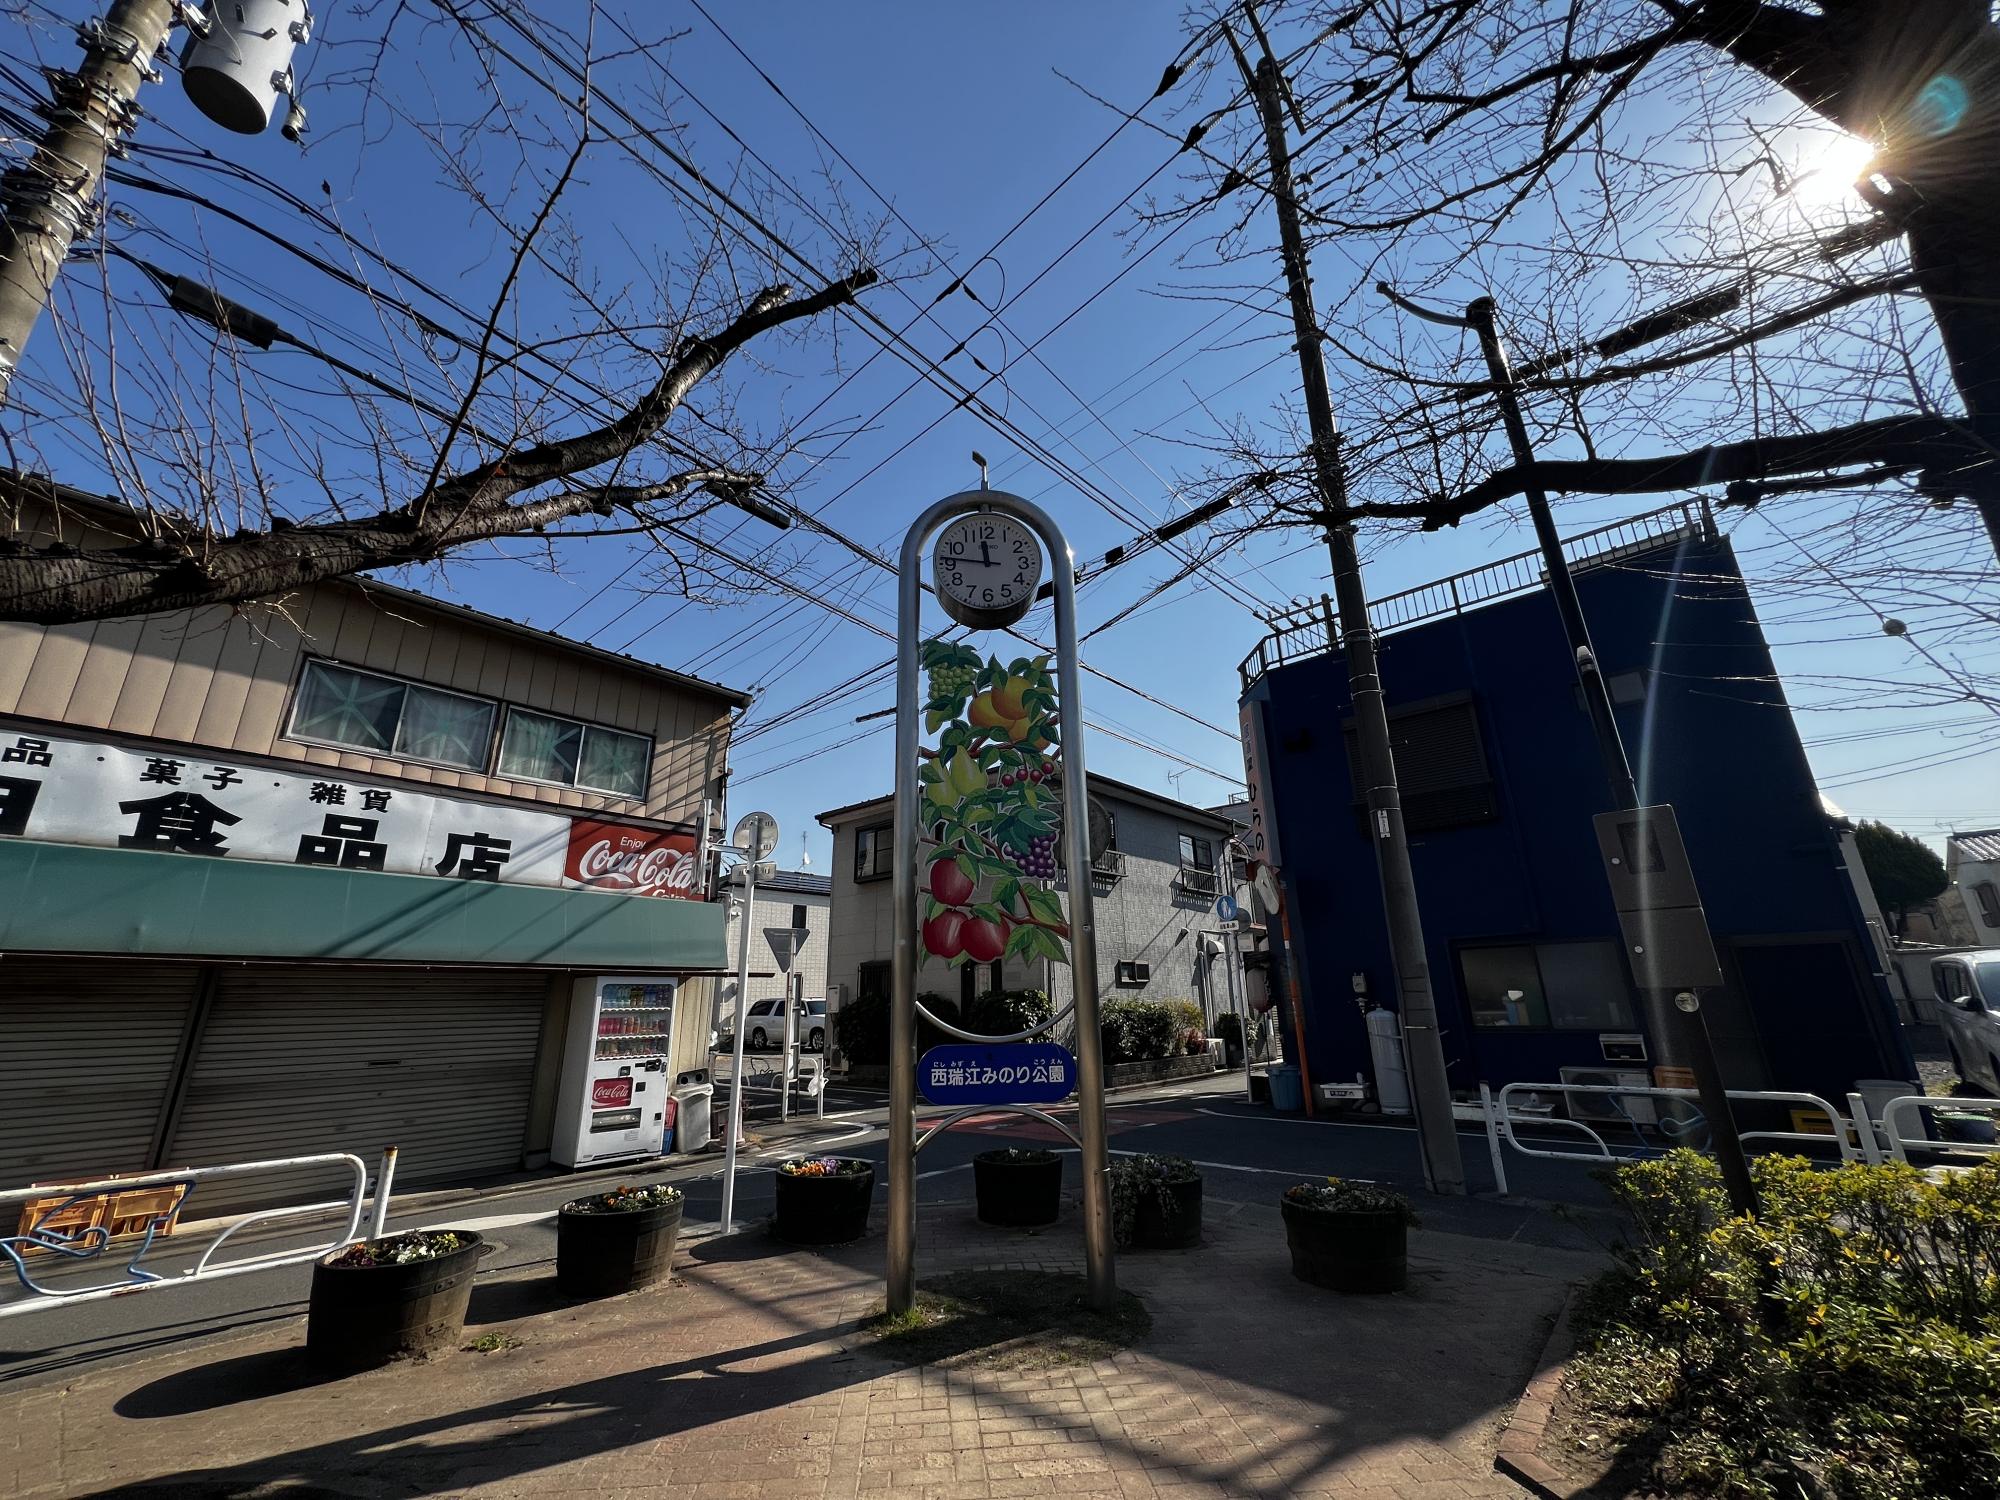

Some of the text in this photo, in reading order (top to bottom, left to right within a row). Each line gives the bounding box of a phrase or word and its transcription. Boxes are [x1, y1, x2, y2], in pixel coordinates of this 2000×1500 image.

[964, 529, 976, 543] 11
[980, 526, 995, 539] 12
[1002, 529, 1007, 543] 1
[949, 541, 964, 555] 10
[1012, 540, 1023, 554] 2
[944, 557, 956, 571] 9
[1018, 556, 1029, 570] 3
[951, 572, 963, 586] 8
[1013, 572, 1025, 585] 4
[966, 585, 977, 598] 7
[982, 588, 994, 602] 6
[1000, 584, 1012, 598] 5
[620, 835, 647, 849] Enjoy
[578, 839, 694, 889] Coca-Cola
[931, 1065, 1065, 1086] 西瑞江みのり公園
